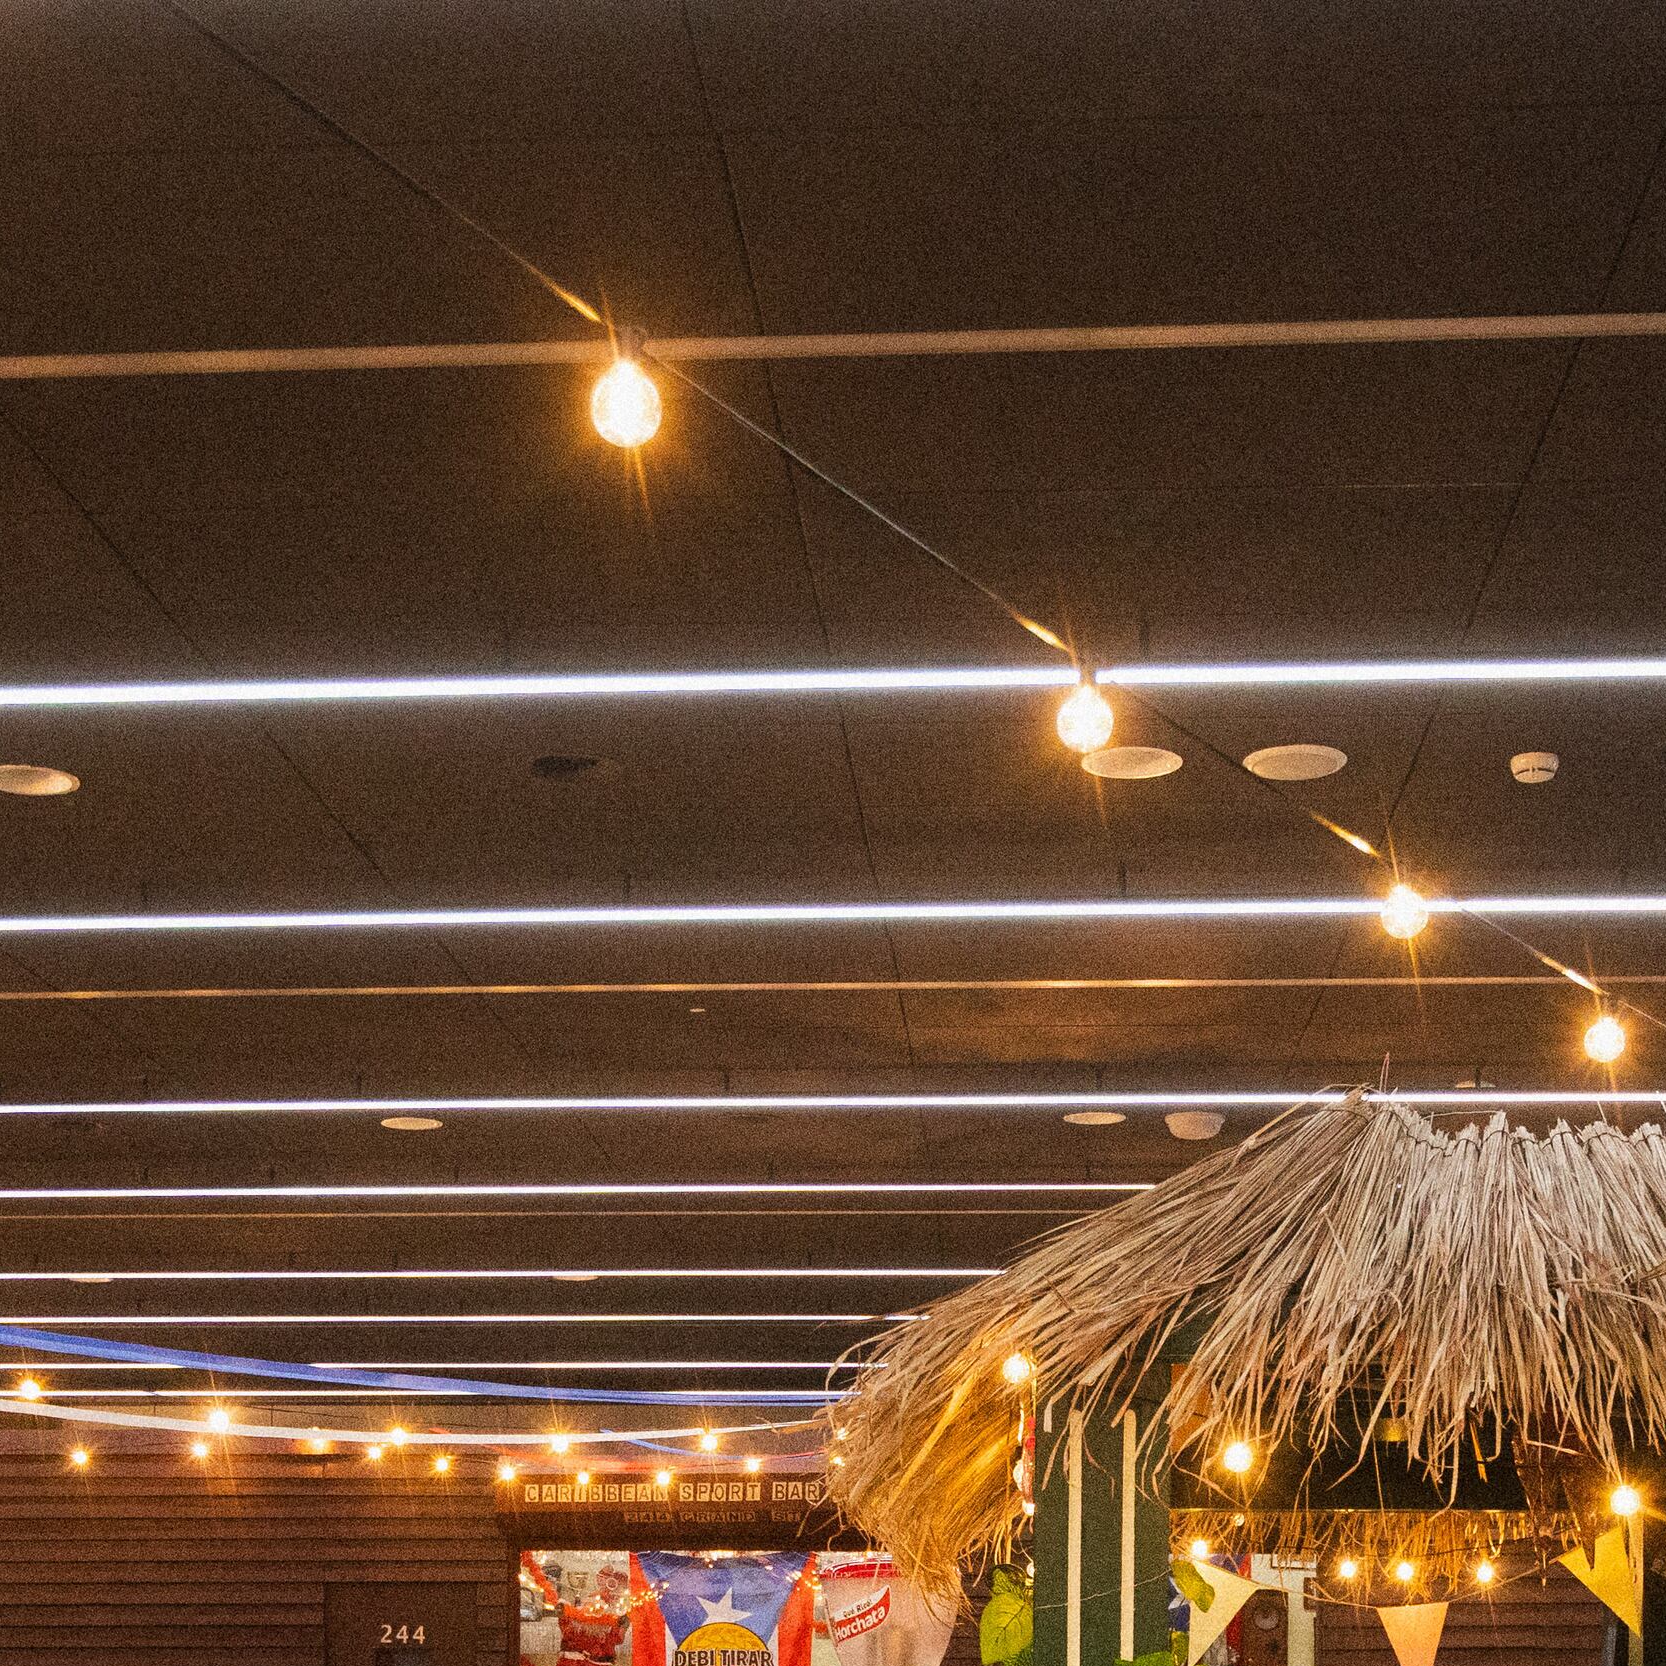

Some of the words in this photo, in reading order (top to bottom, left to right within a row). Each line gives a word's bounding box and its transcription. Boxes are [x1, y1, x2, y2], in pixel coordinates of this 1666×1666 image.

[526, 1485, 668, 1501] CARIBBEAN
[681, 1484, 760, 1500] SPORT
[774, 1482, 820, 1499] BAR
[680, 1511, 755, 1522] GRAND
[835, 1606, 886, 1640] Horchata
[380, 1624, 426, 1644] 244
